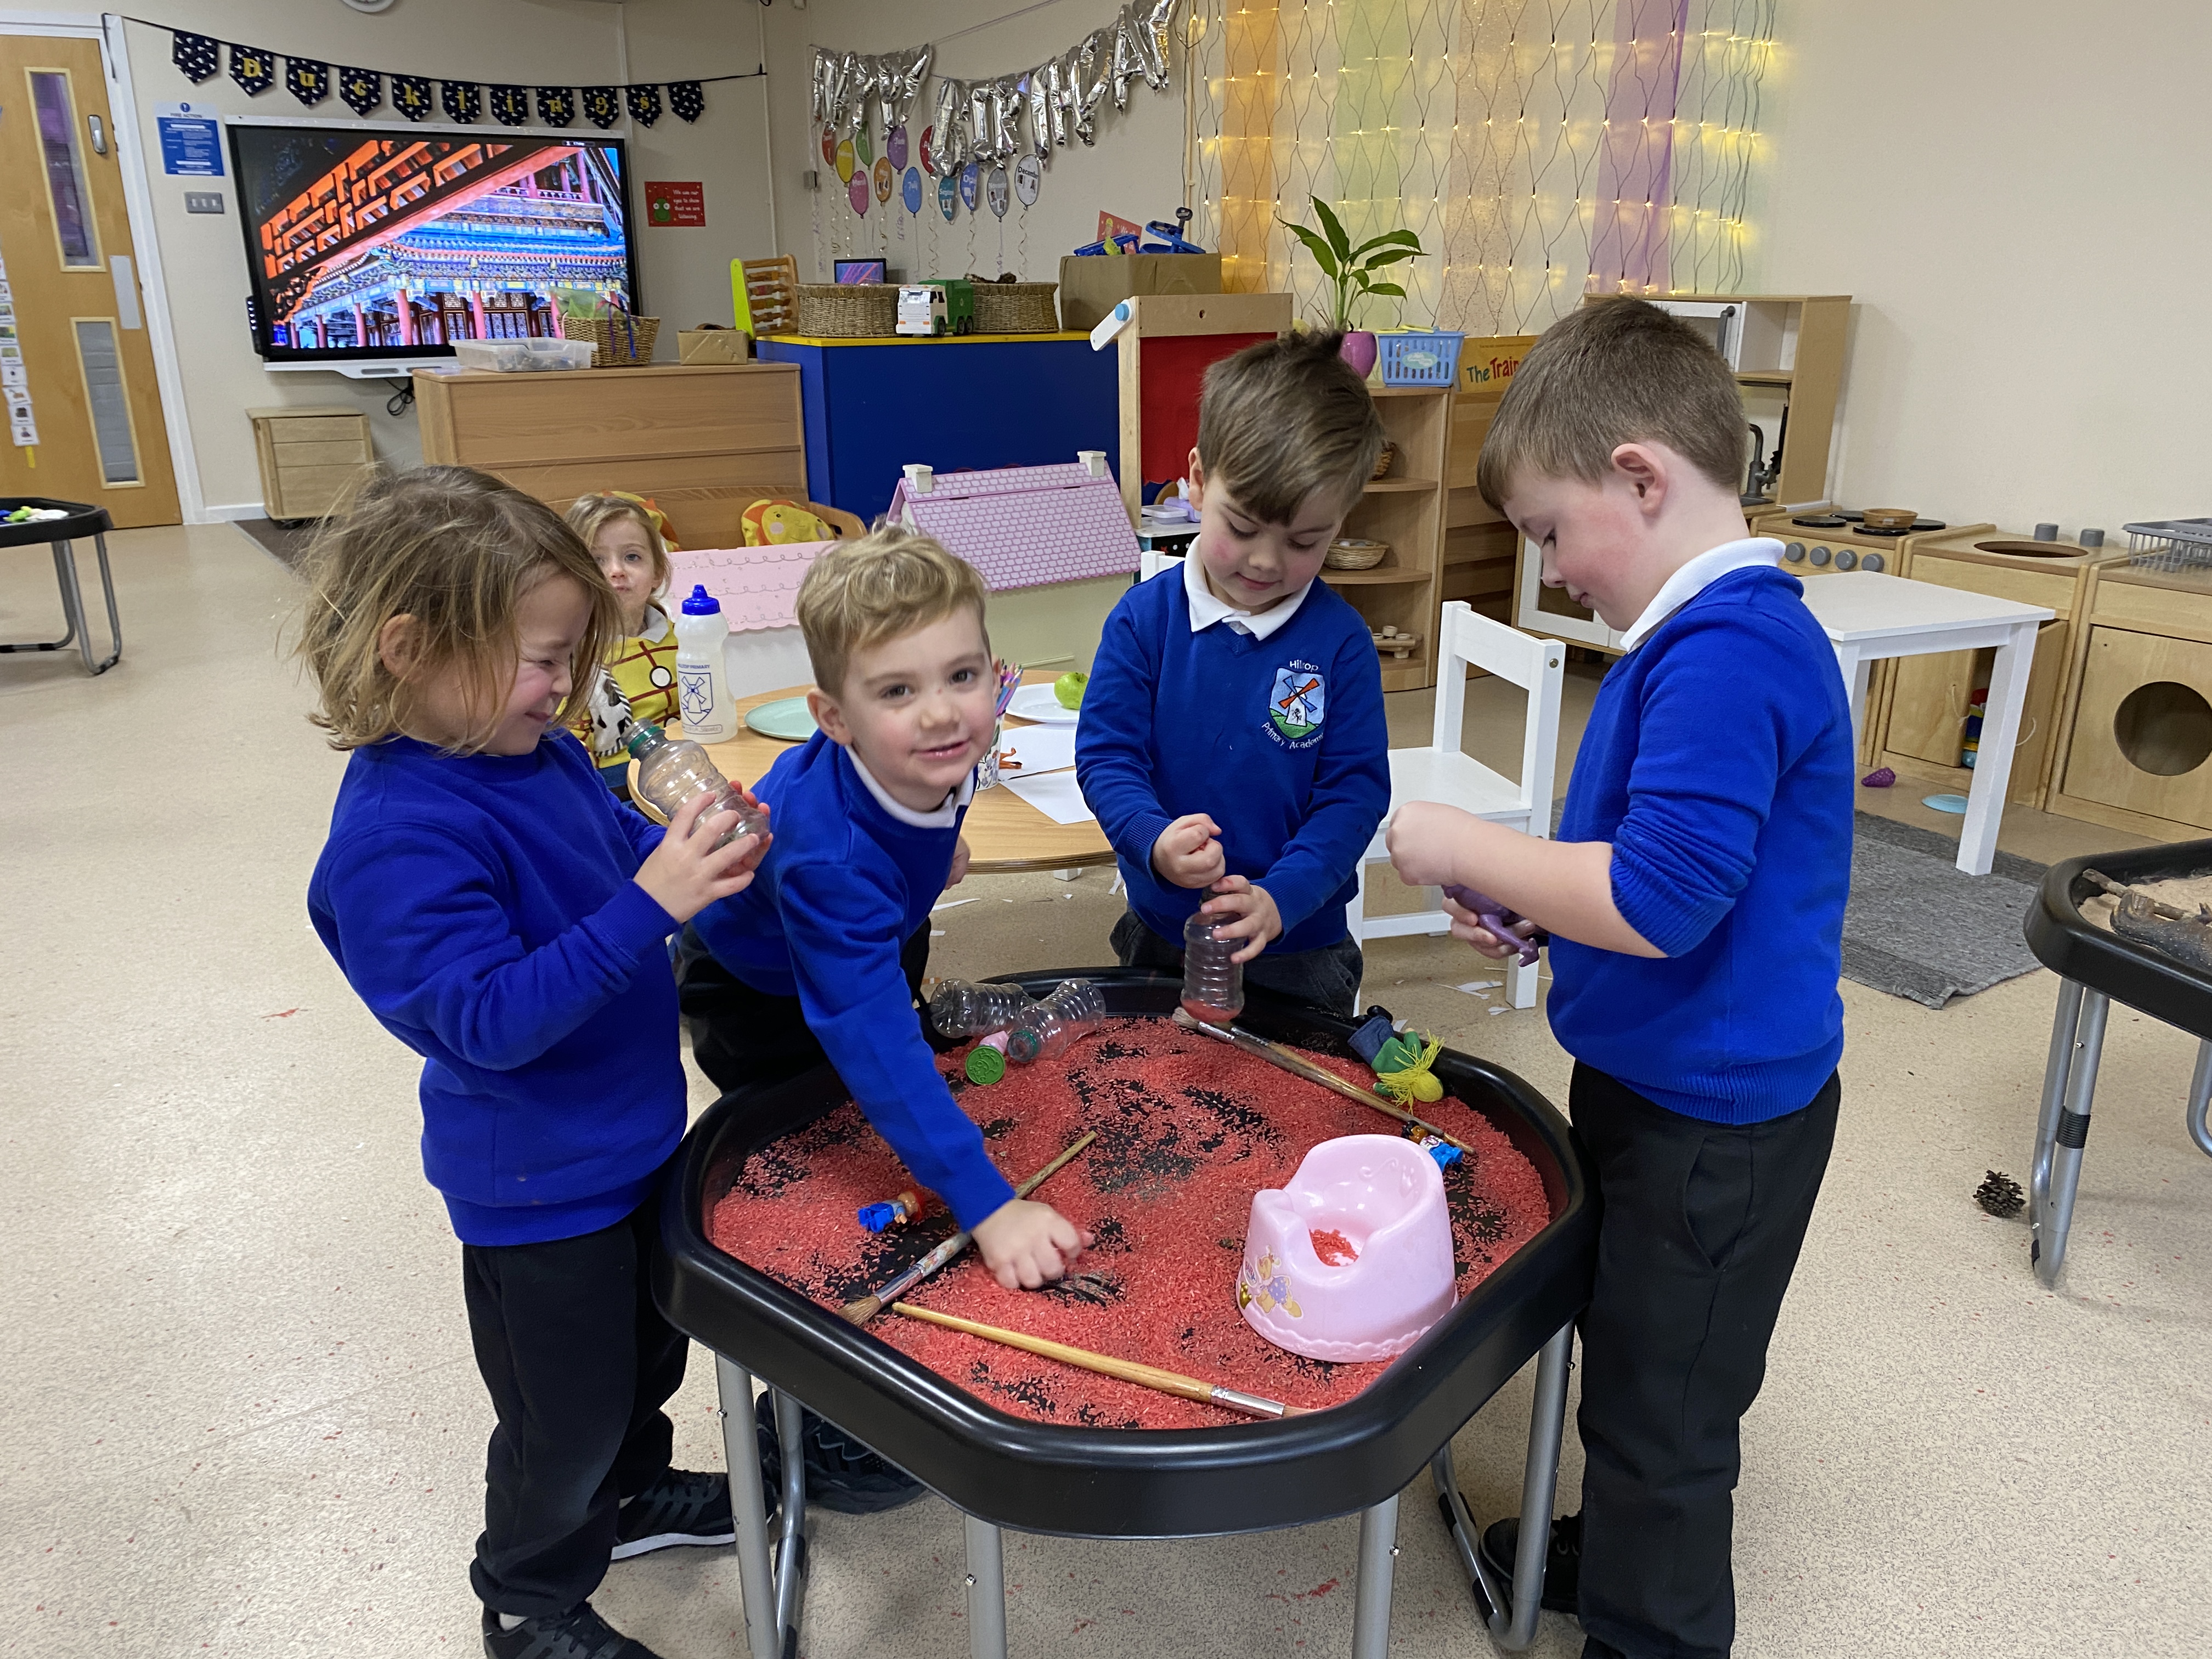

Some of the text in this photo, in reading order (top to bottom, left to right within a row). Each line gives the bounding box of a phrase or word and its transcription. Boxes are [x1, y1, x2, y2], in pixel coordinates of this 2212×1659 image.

[243, 57, 650, 116] Ducklings
[1466, 365, 1490, 383] The
[1261, 722, 1285, 747] Primary
